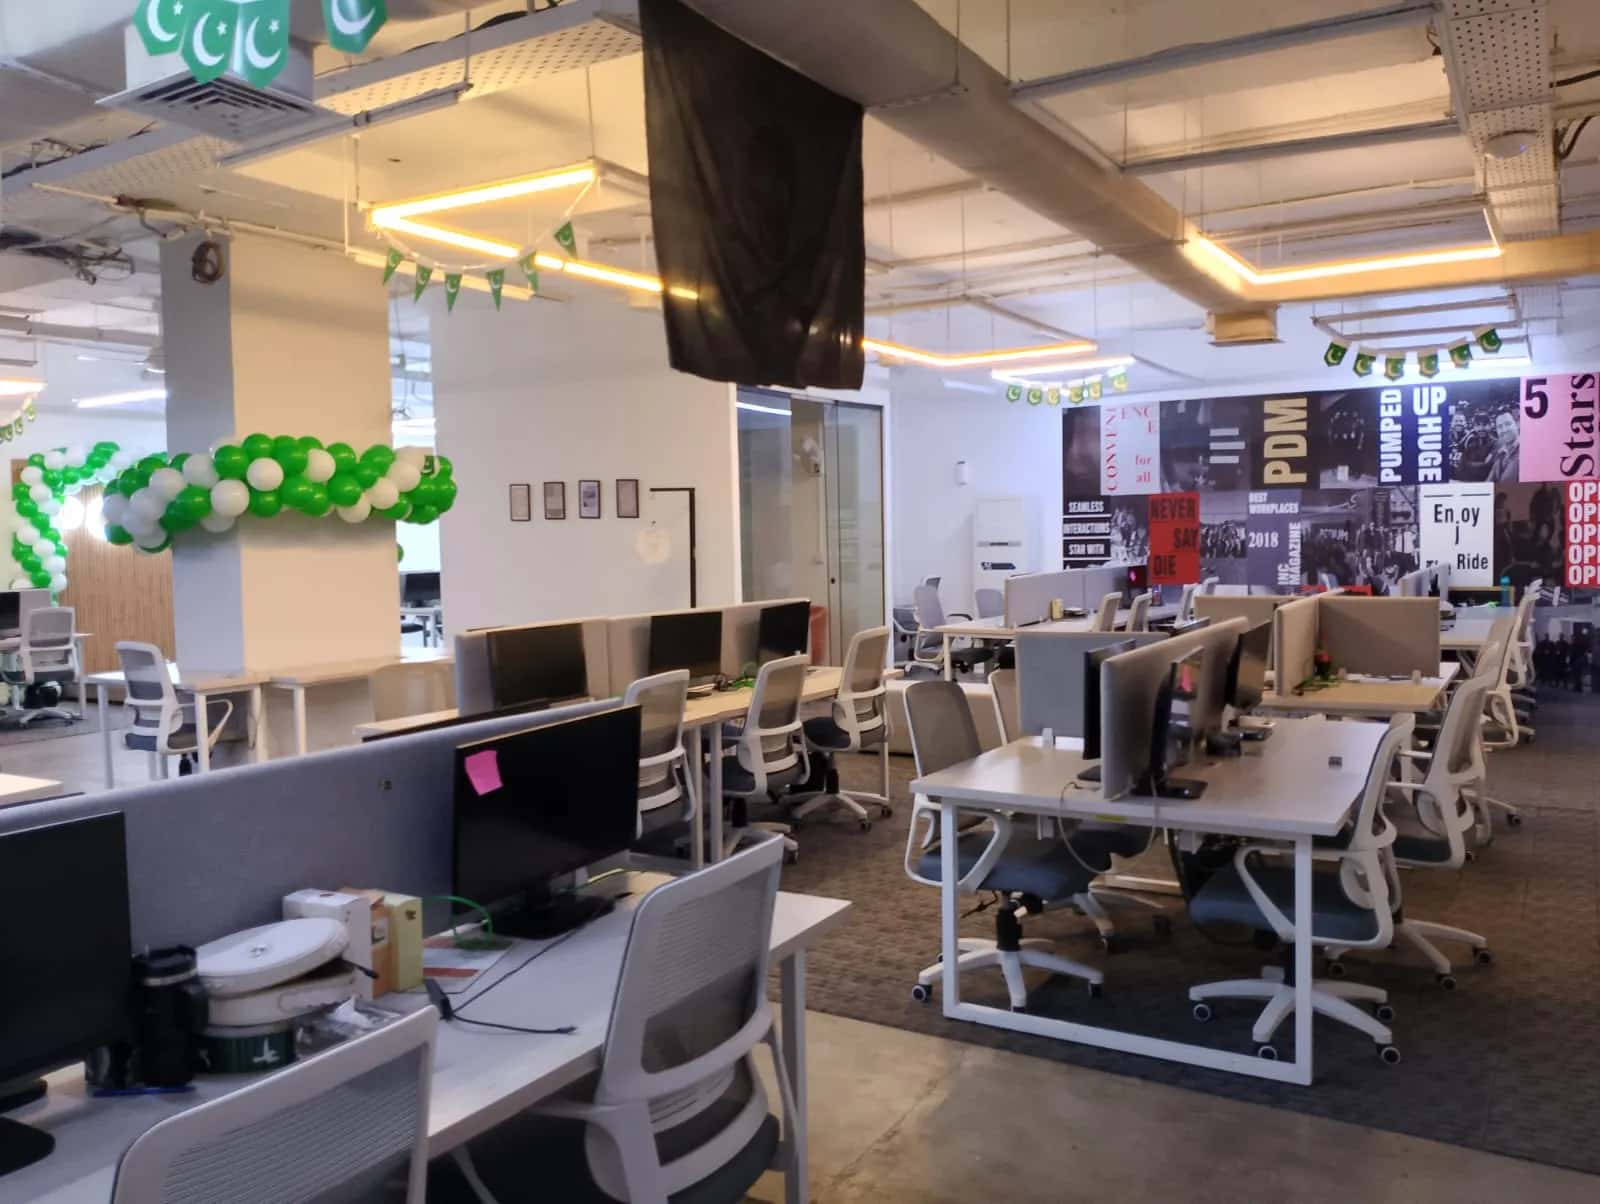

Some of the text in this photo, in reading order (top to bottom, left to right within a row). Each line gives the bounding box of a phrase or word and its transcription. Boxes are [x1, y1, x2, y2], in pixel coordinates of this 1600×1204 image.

[1413, 386, 1447, 415] UP
[1524, 379, 1549, 419] 5
[1380, 389, 1403, 483] PUMPED
[1560, 373, 1596, 477] Stars
[1264, 397, 1308, 484] PDM
[1418, 416, 1442, 482] HUGE
[1569, 482, 1600, 502] OP
[1151, 497, 1195, 520] NEVER
[1569, 503, 1600, 523] OP
[1173, 527, 1199, 549] SAY
[1248, 531, 1279, 549] 2018
[1569, 524, 1600, 544] OP
[1289, 522, 1301, 586] MAGAZINE
[1456, 553, 1489, 570] Ride
[1569, 545, 1600, 564] OP
[1153, 555, 1177, 577] DIE
[1569, 566, 1600, 585] OP
